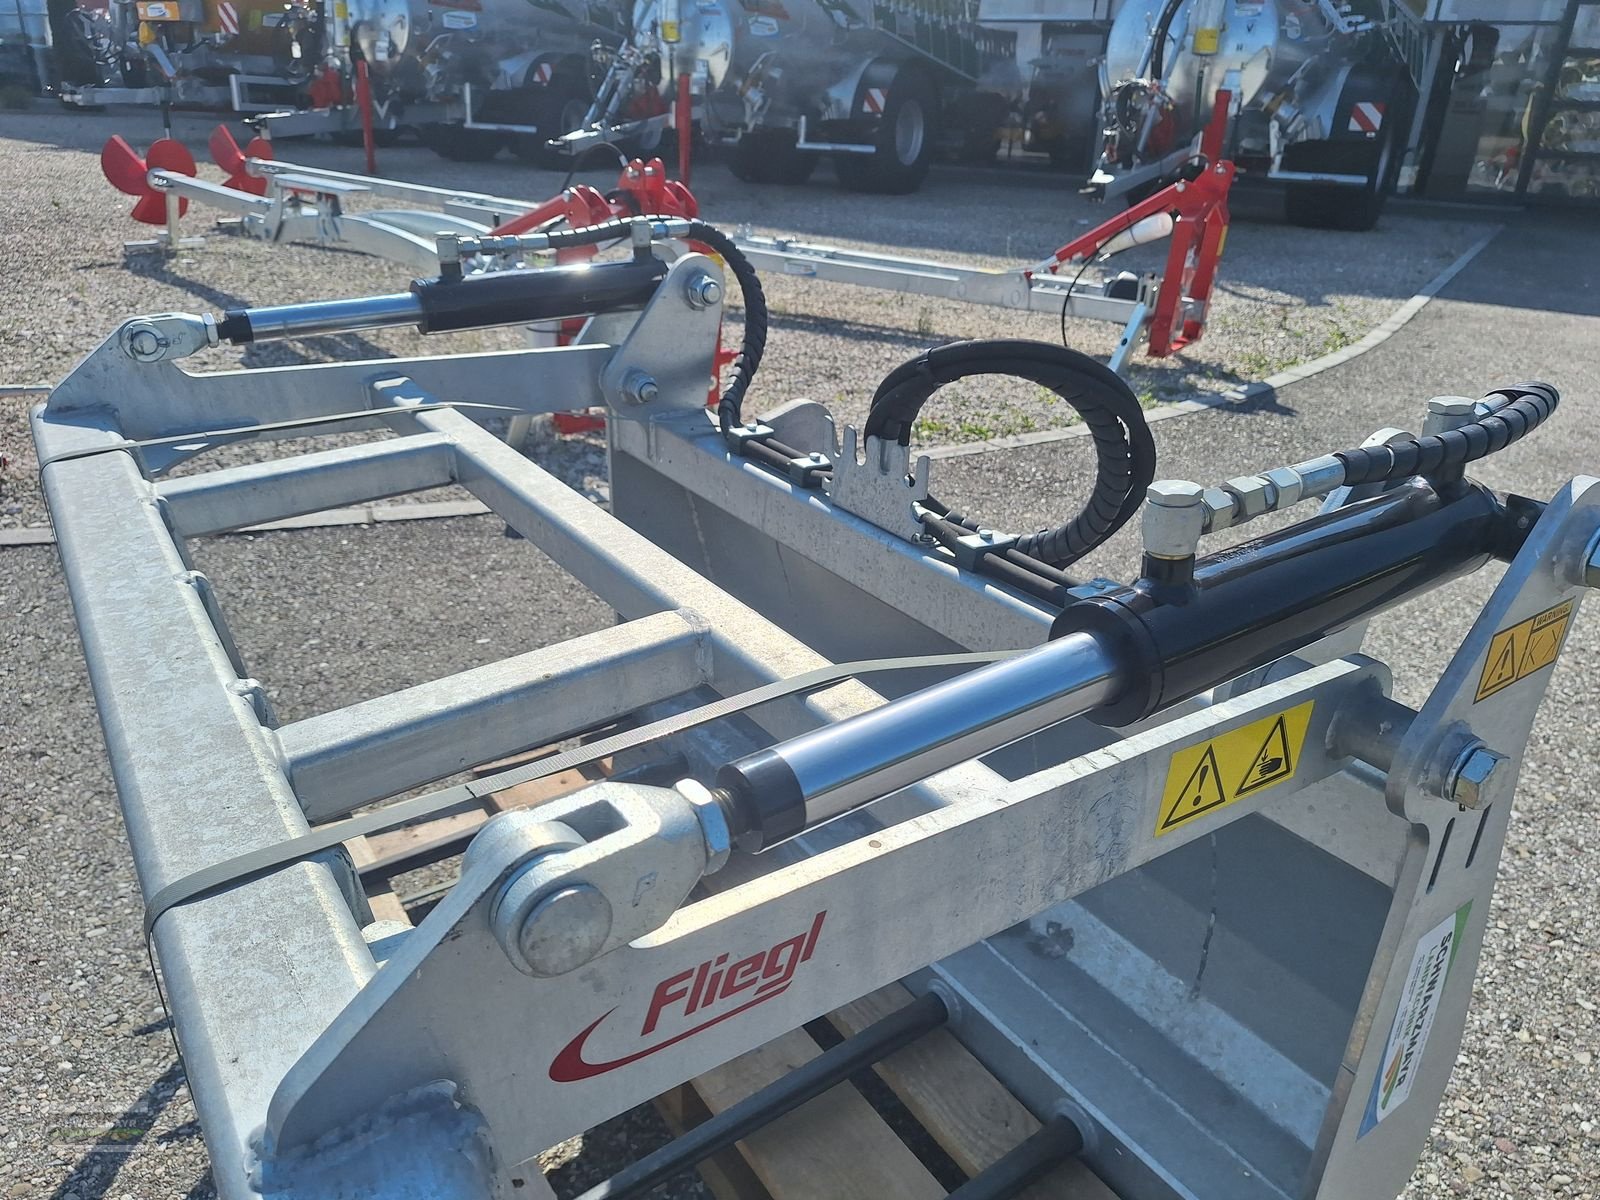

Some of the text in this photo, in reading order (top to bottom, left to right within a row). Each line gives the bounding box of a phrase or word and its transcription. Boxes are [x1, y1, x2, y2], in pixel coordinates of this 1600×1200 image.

[1536, 603, 1570, 627] WARNING
[641, 910, 827, 1036] Fliegl
[1395, 931, 1453, 1088] SCHWARZMAYR
